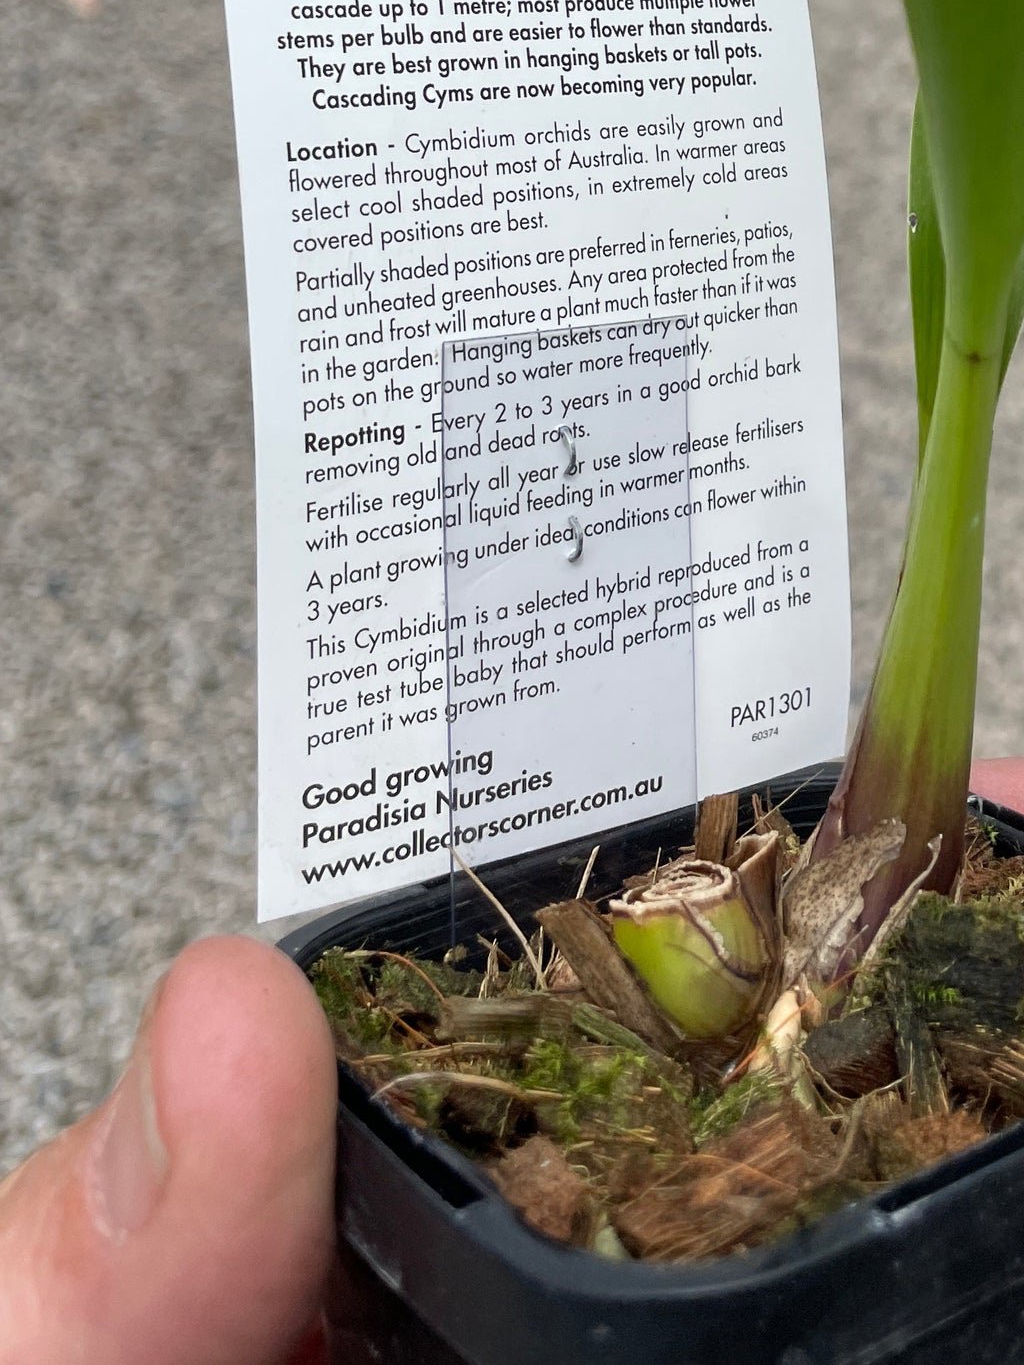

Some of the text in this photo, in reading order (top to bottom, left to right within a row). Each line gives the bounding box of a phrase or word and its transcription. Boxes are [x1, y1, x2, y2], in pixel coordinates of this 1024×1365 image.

[277, 13, 772, 54] stems per bulb and are easier to flower than standards.
[379, 3, 403, 23] up
[409, 0, 428, 16] to
[297, 40, 762, 83] They are best grown in hanging baskets or tall pots.
[312, 67, 756, 111] Cascading Cyms are now becoming very popular.
[286, 137, 378, 162] Location
[405, 126, 515, 159] Cymbidium
[524, 120, 591, 145] orchids
[599, 126, 629, 139] are
[637, 114, 685, 140] easily
[693, 118, 745, 138] grown
[753, 107, 783, 128] and
[289, 140, 786, 192] flowered throughout most of Australia. In warmer areas
[292, 162, 788, 223] select cool shaded positions, in extremely cold areas
[293, 209, 548, 253] covered positions are best.
[296, 221, 793, 292] Partially shaded positions are preferred in ferneries, patios,
[298, 243, 795, 322] and unheated greenhouses. Any area protected from the
[306, 540, 809, 660] This Cymbidium is a selected hybrid reproduced from a
[307, 595, 388, 624] 3 years.
[307, 565, 810, 697] proven original through a complex procedure and is a
[307, 586, 811, 719] true test tube baby that should perform as well as the
[307, 678, 560, 756] parent it was grown from.
[731, 687, 810, 728] PAR1301
[752, 727, 778, 742] 60374
[302, 750, 493, 810] Good growing
[301, 776, 663, 884] www.collectorscorner.com.au
[303, 769, 553, 849] Paradisia Nurseries
